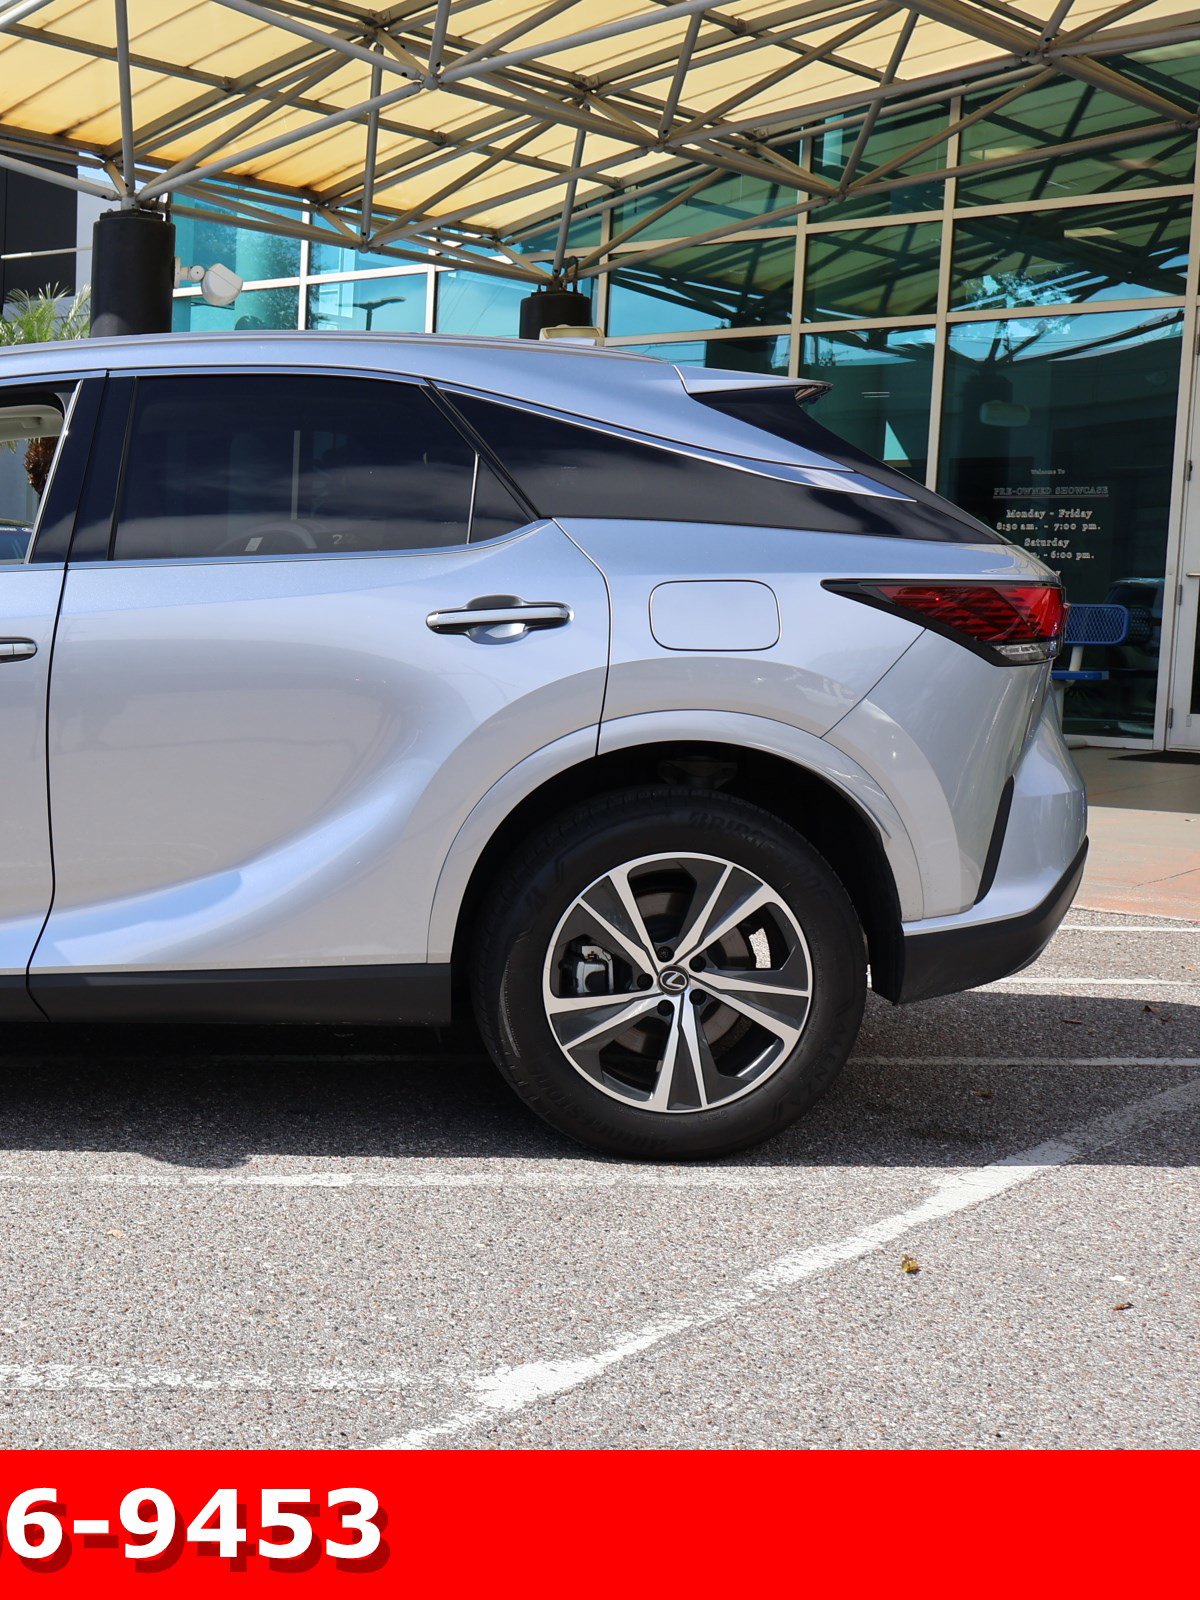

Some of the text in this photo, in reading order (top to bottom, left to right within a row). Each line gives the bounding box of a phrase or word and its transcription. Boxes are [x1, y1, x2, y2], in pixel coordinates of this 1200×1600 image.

[994, 486, 1108, 495] PRE-OWNED SHOWCASE
[1006, 509, 1046, 519] Monday
[1058, 509, 1093, 519] Friday
[996, 522, 1018, 531] 8:30
[1053, 523, 1077, 531] 7:00
[1081, 523, 1101, 532] pm.
[1024, 537, 1070, 548] Saturday
[1050, 550, 1073, 559] 6:00
[1075, 552, 1095, 560] pm.
